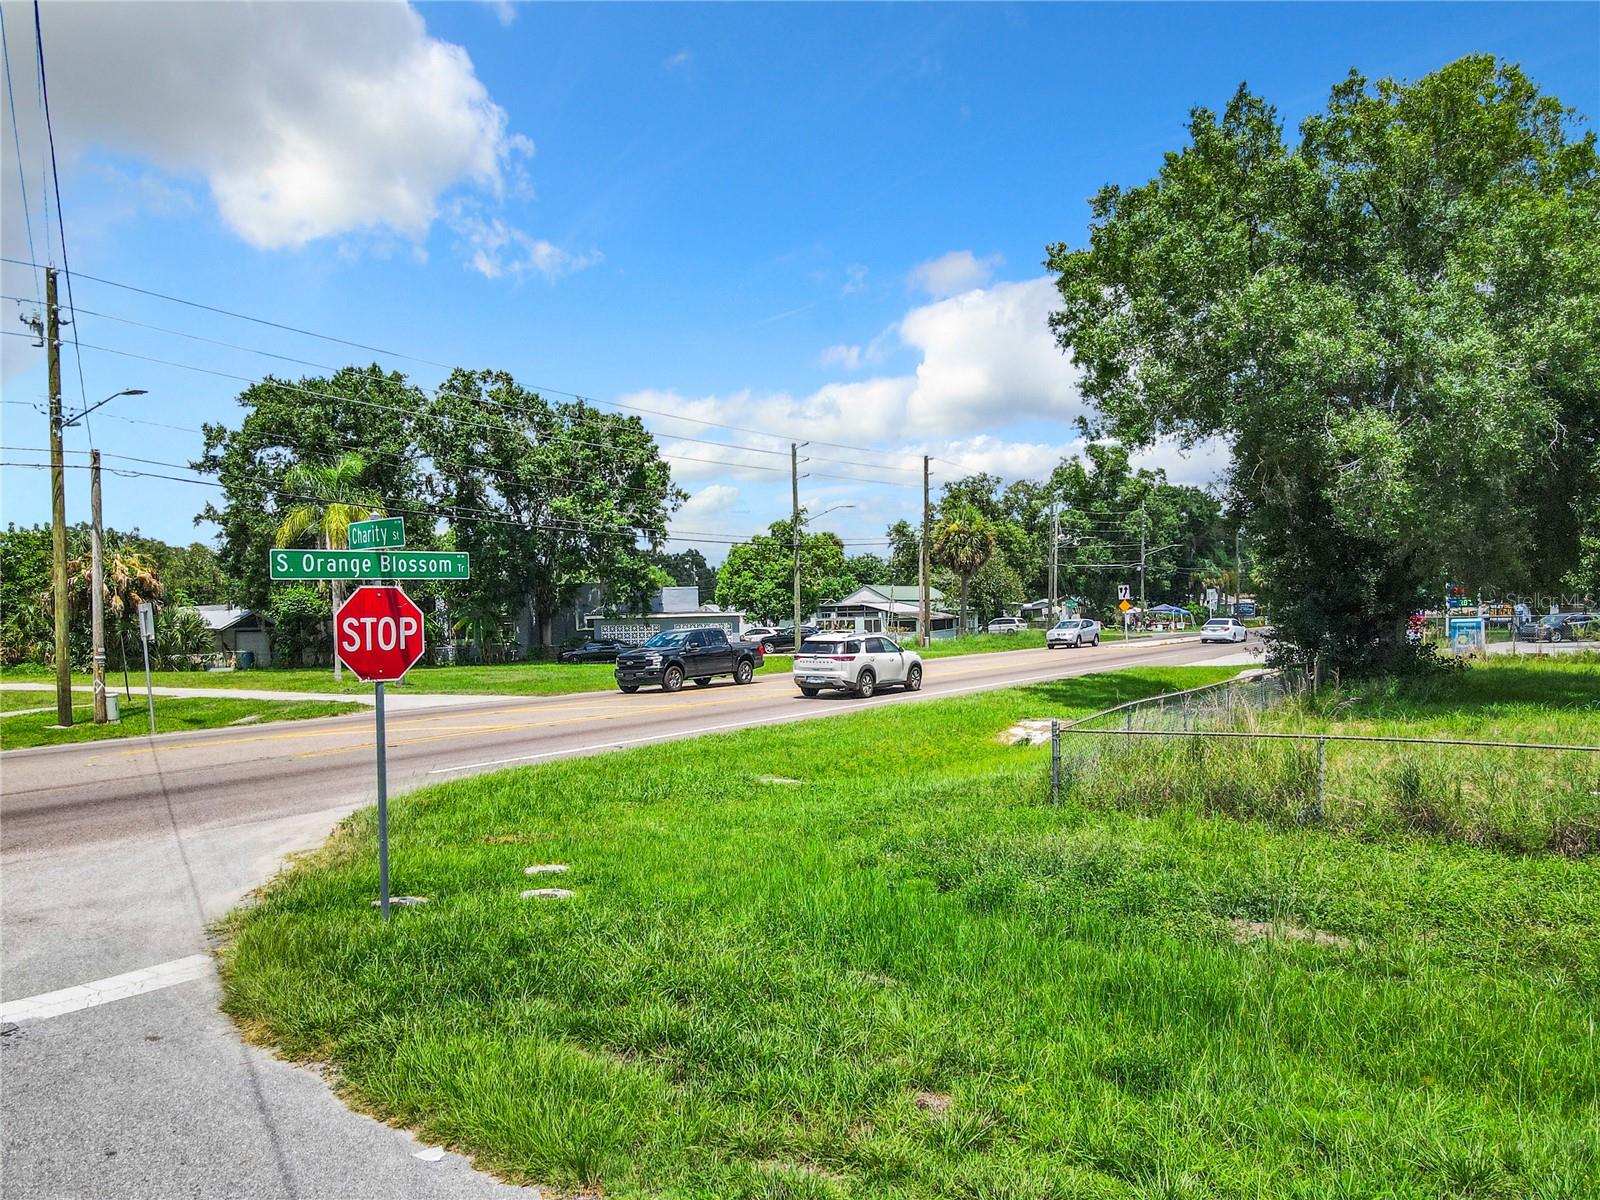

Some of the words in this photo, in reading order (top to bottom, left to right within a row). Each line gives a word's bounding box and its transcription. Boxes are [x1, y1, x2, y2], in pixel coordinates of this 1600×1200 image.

[351, 524, 388, 546] Charity
[392, 530, 400, 540] St
[276, 553, 294, 573] S.
[302, 553, 372, 578] Orange
[380, 554, 452, 573] Blossom
[456, 563, 465, 573] Tr
[342, 616, 418, 653] STOP
